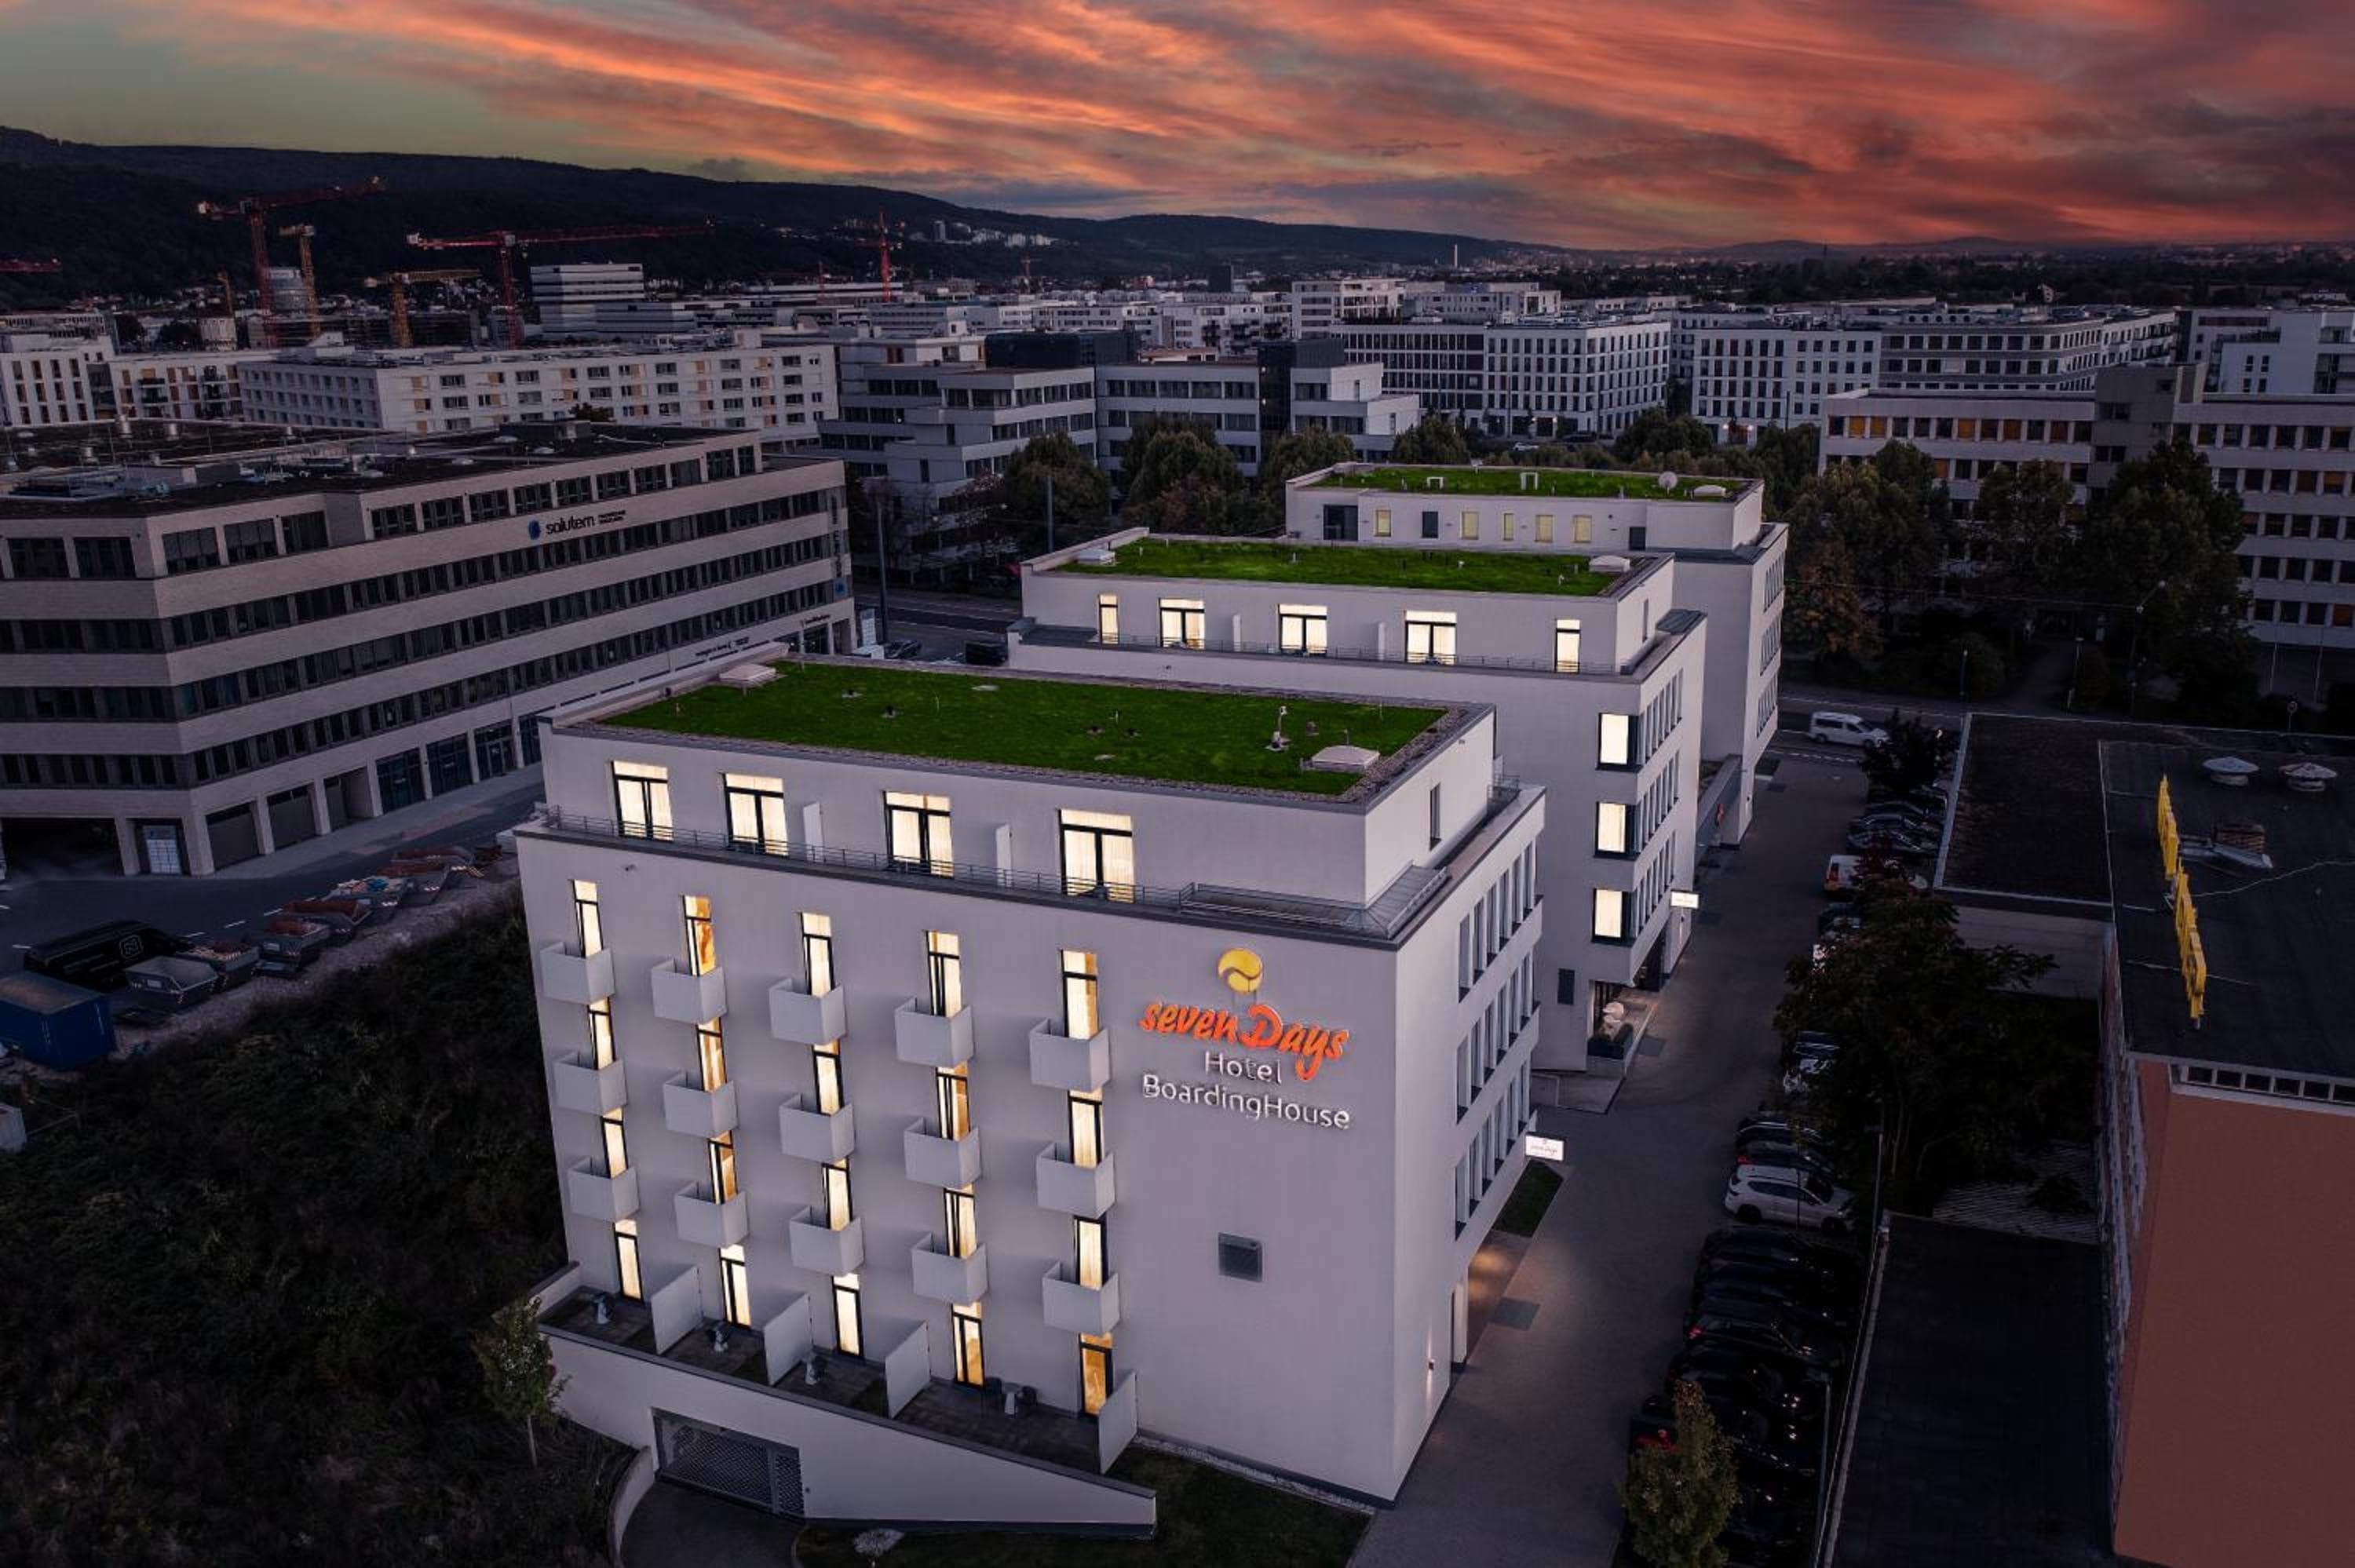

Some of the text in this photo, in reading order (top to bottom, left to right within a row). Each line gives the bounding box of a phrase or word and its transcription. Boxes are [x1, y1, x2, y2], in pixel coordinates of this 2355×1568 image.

[546, 516, 595, 534] salutem
[1204, 1050, 1283, 1085] Hotel
[1142, 1074, 1351, 1130] BoardingHouse
